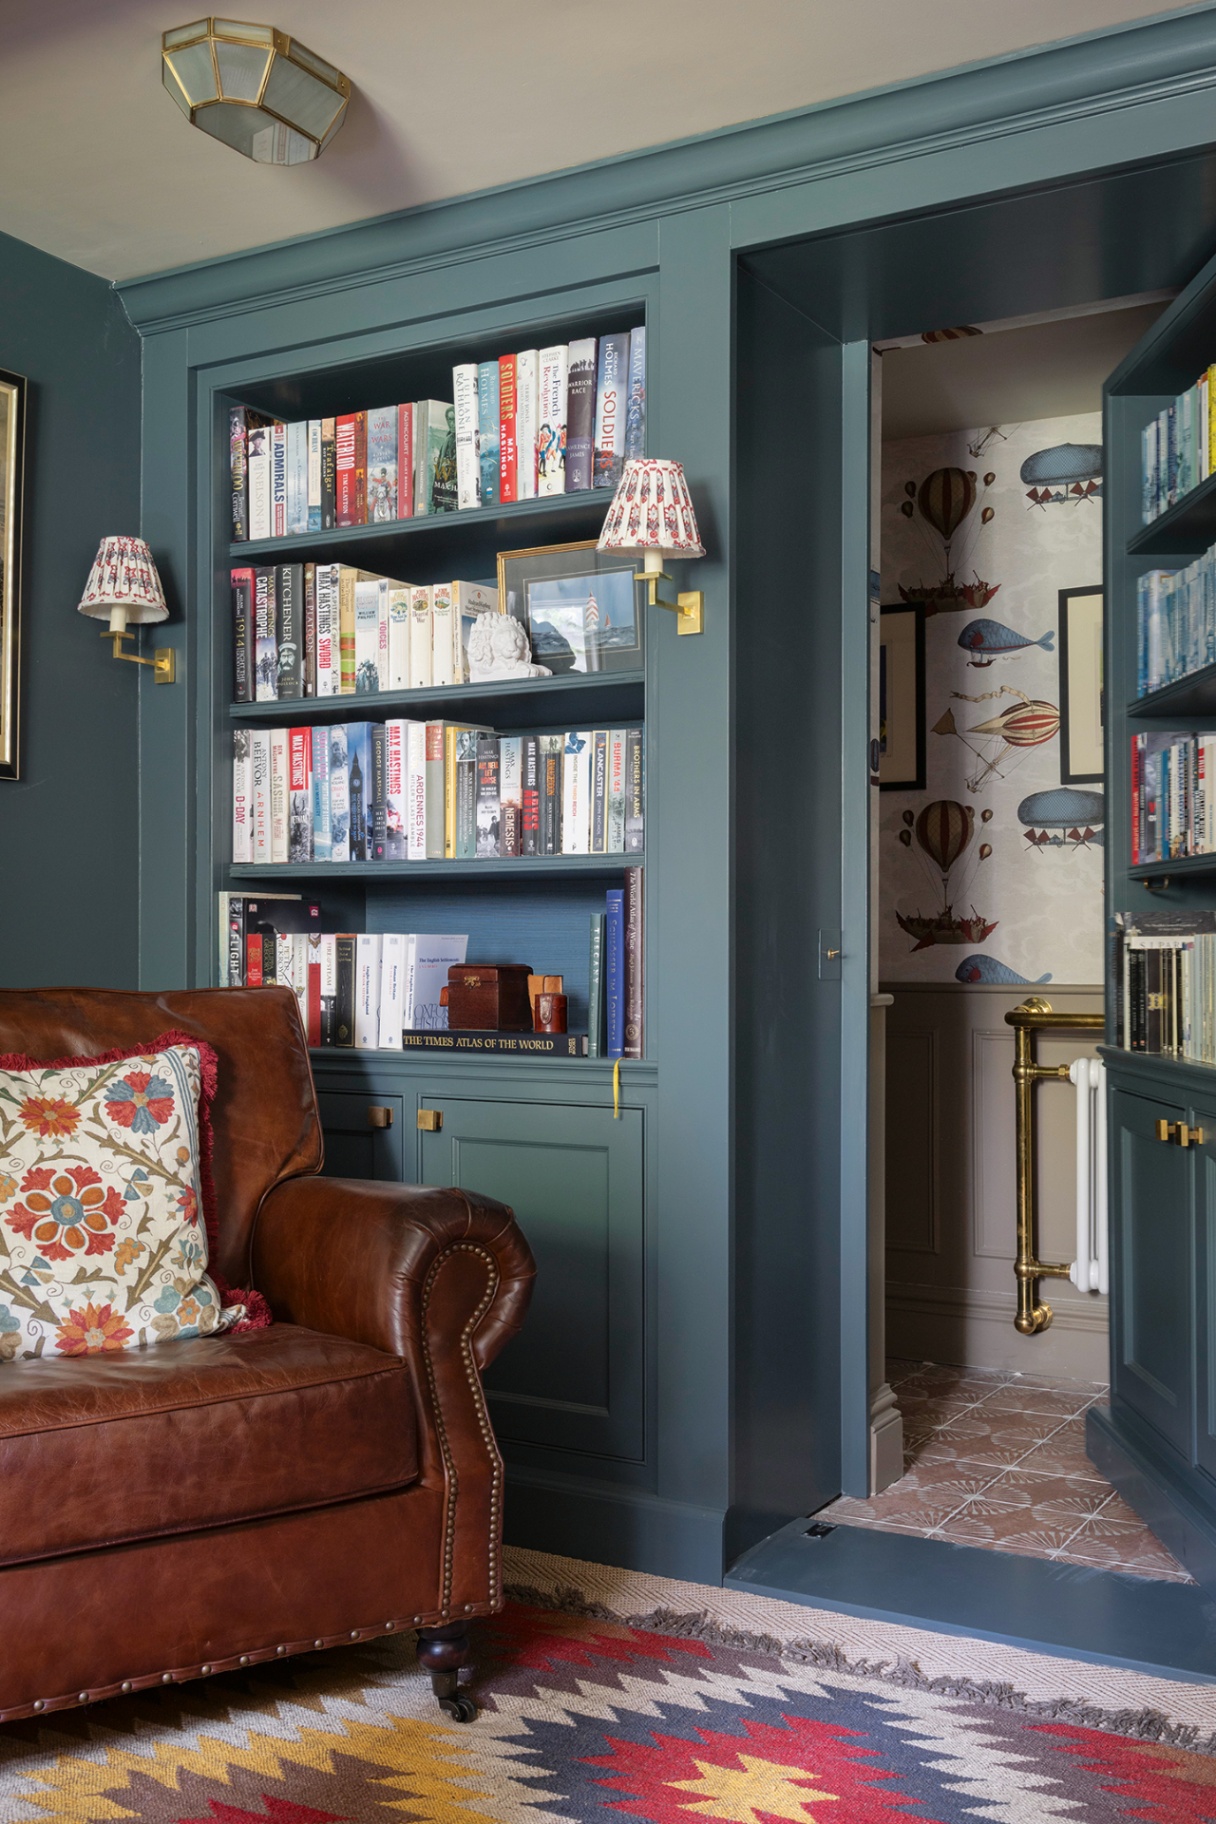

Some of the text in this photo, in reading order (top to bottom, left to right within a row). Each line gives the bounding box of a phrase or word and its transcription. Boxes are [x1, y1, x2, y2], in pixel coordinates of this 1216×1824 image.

[604, 342, 614, 386] HOLMES
[630, 348, 643, 420] MAVERICKS
[456, 372, 465, 431] RATHBONE
[463, 377, 471, 423] JULIAN
[480, 368, 490, 415] HOLMES
[500, 362, 514, 420] SOLDIERS
[541, 366, 551, 419] Revolution
[551, 379, 561, 417] French
[571, 387, 587, 395] RACE
[336, 421, 355, 471] WATERLOO
[371, 434, 393, 443] WARS
[373, 421, 392, 430] WAR
[600, 391, 617, 469] SOLDIERS
[274, 443, 285, 502] ADMIRALS
[324, 444, 334, 493] Trafalgar
[255, 471, 264, 517] NELSON
[256, 576, 268, 639] CATASTROPHE
[267, 597, 275, 638] HASTINGS
[282, 567, 292, 642] KITCHENER
[318, 571, 332, 669] MAX HASTINGS SWORD
[235, 618, 246, 647] 1914
[305, 605, 314, 653] PLATOON
[379, 620, 388, 650] VOICES
[254, 741, 262, 787] BEEVOR
[292, 735, 303, 786] MAX HASTINGS
[389, 726, 401, 795] MAX HASTINGS
[528, 742, 536, 787] MAX HASTINGS
[596, 748, 604, 797] LANCASTER
[613, 742, 621, 778] BURMA
[633, 745, 641, 818] BROTHERS IN ARMS
[273, 775, 283, 796] SAS
[235, 795, 246, 825] D-DAY
[256, 792, 264, 847] ARNHEM
[416, 774, 424, 848] ARDENNES 1944
[505, 807, 514, 846] NEMESIS
[523, 789, 539, 831] ABYSS
[230, 934, 239, 974] FLIGHT
[592, 927, 600, 985] TUSCANY
[629, 932, 637, 950] Wine
[414, 1003, 449, 1020] OXFOR
[403, 1035, 554, 1050] THE TIMES ATLAS OF THE WORLD
